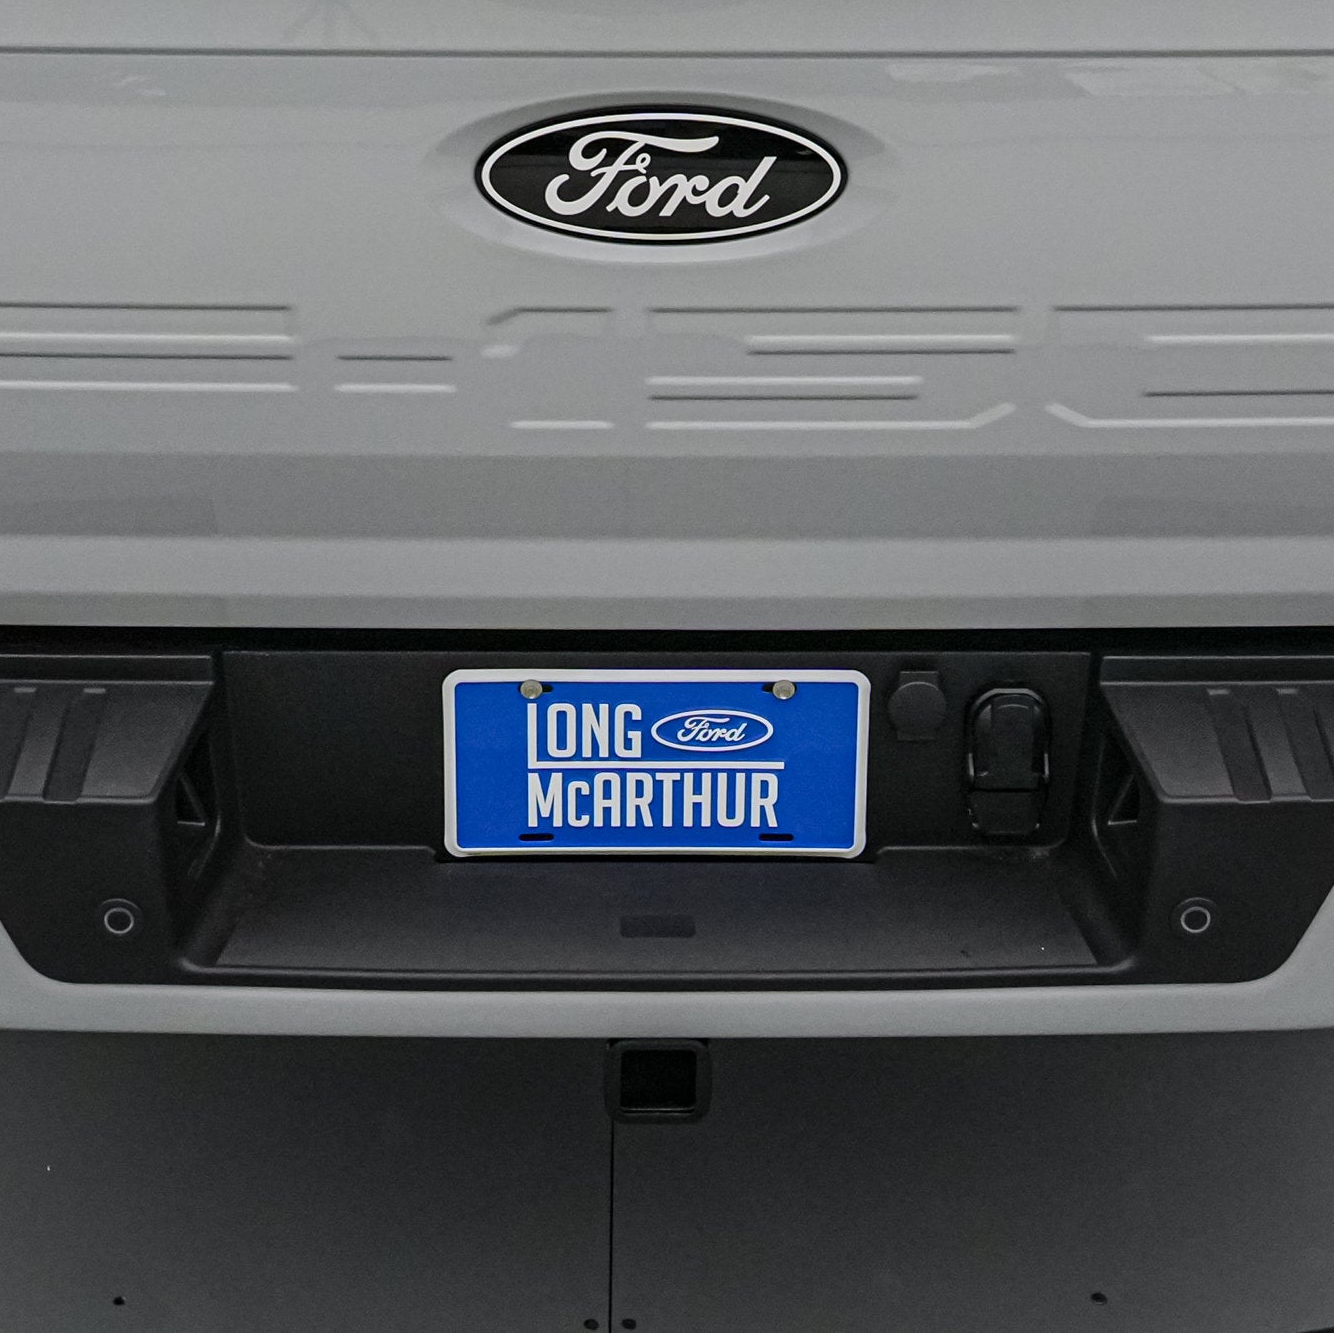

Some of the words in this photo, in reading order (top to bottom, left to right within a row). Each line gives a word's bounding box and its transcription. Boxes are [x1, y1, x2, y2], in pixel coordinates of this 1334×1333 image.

[545, 130, 771, 218] Ford
[527, 703, 642, 768] LONG
[677, 716, 747, 743] Ford
[527, 772, 779, 828] McARTHUR
